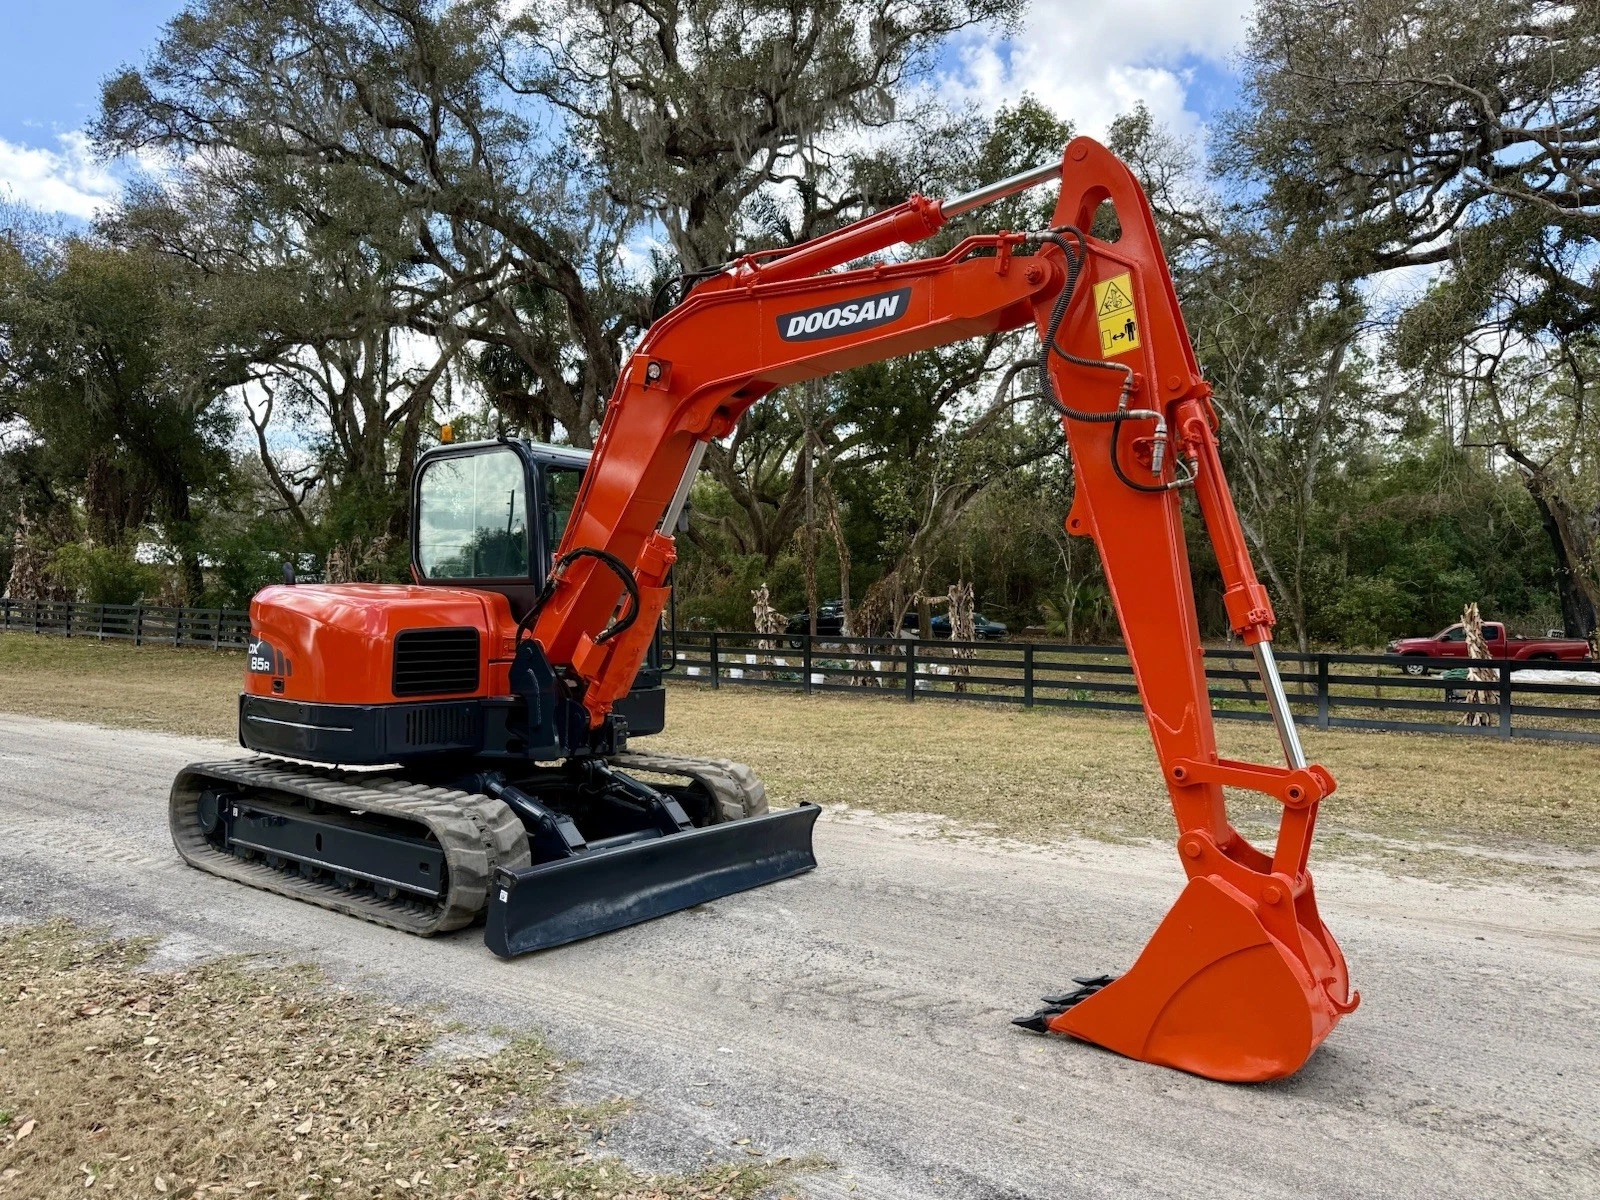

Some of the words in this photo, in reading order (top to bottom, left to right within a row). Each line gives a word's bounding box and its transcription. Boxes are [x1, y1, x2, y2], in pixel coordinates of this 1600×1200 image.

[787, 295, 899, 337] DOOSAN
[249, 641, 263, 654] DX
[251, 657, 270, 671] 85R
